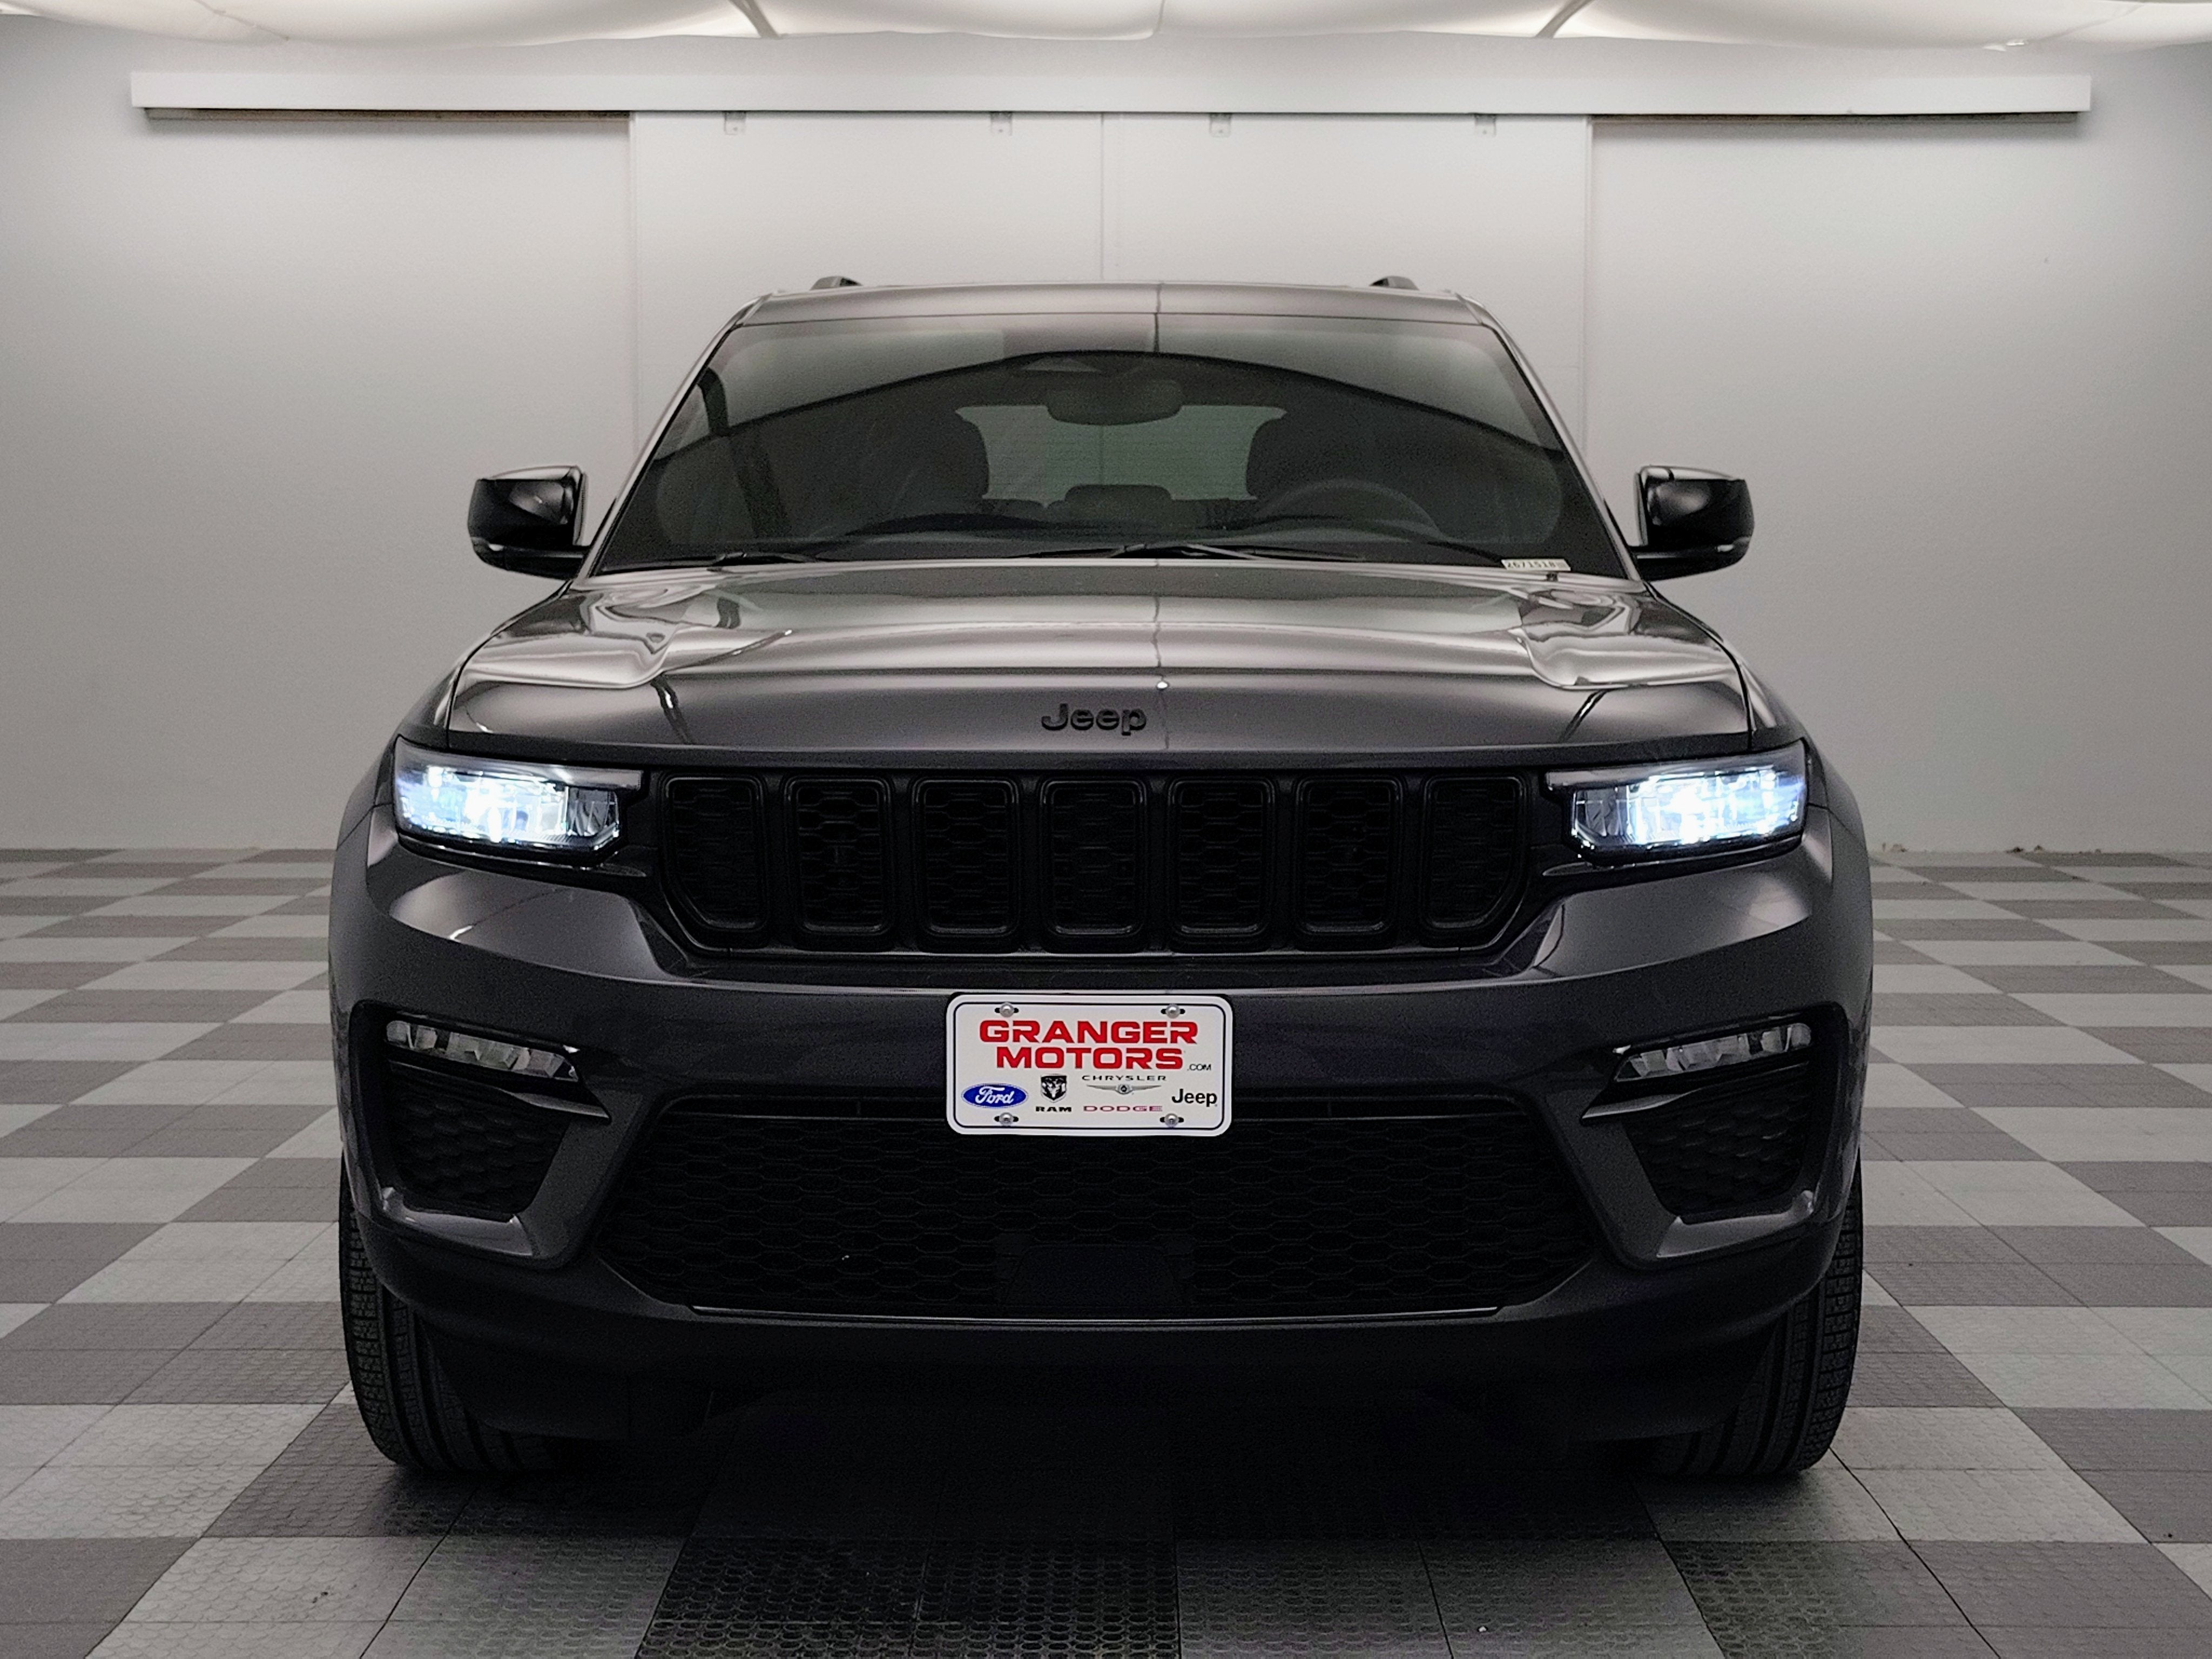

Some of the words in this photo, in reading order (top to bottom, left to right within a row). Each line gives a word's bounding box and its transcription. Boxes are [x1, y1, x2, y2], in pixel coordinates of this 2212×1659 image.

[1041, 703, 1147, 736] Jeep
[979, 1020, 1198, 1044] GRANGER
[996, 1046, 1183, 1070] MOTORS
[974, 1086, 1015, 1104] Ford
[1171, 1088, 1217, 1107] Jeep
